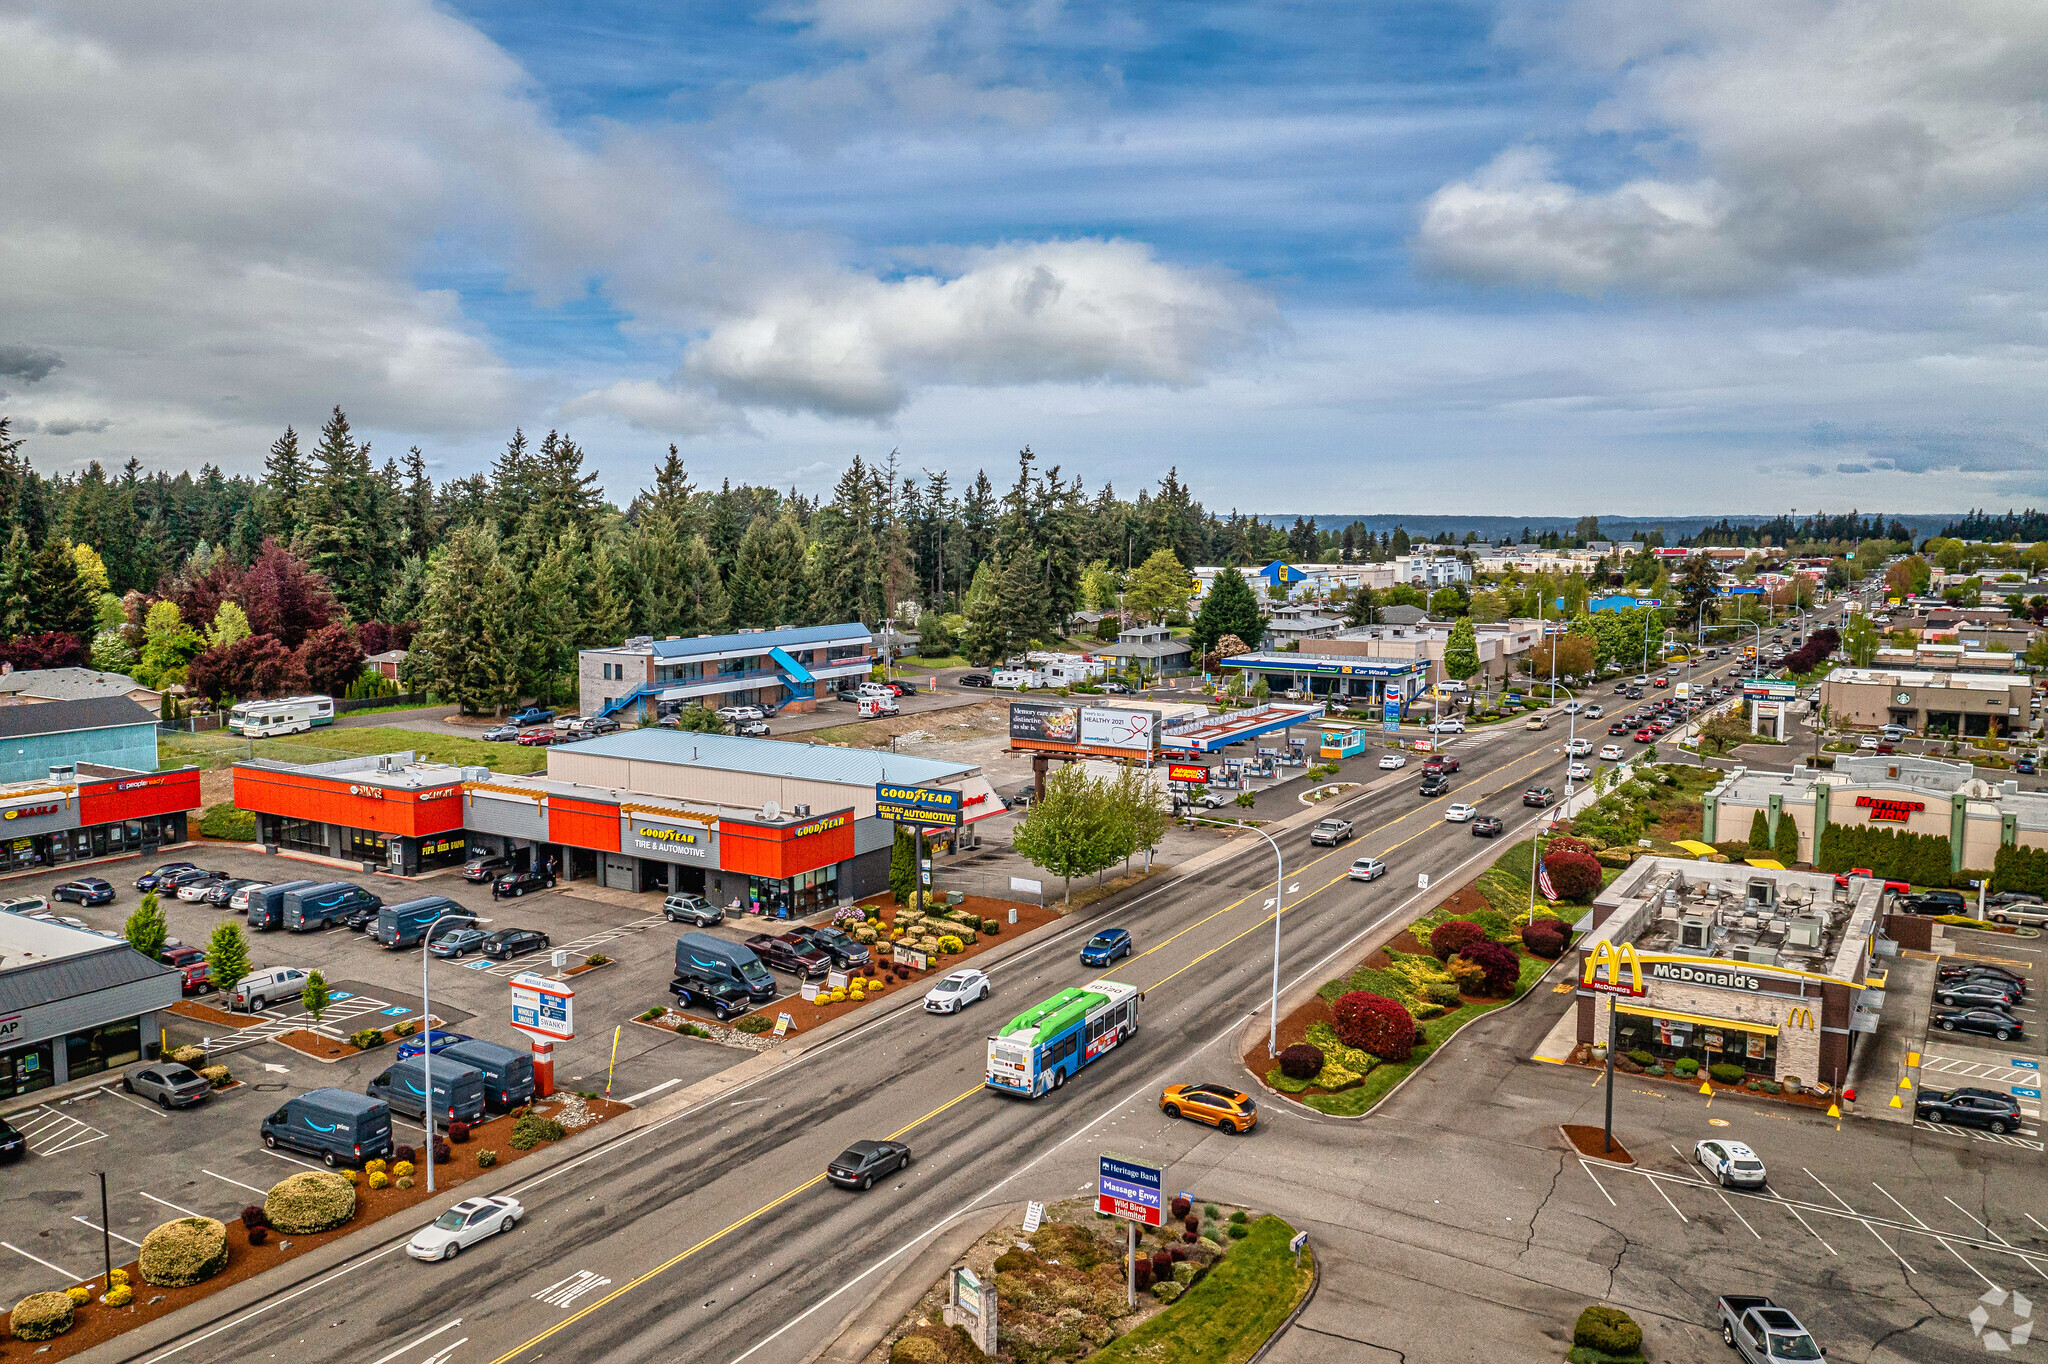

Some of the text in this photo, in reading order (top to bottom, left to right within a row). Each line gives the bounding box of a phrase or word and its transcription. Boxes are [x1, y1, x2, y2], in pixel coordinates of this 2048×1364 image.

[1014, 708, 1036, 716] Memory
[1013, 716, 1041, 724] distinctive
[126, 778, 164, 790] peopleready
[881, 788, 952, 804] GOODYEAR
[17, 804, 59, 818] NAILS
[878, 805, 904, 814] SEA-TAC
[1856, 796, 1925, 812] MATTRESS
[904, 809, 956, 822] AUTOMOTIVE
[1870, 808, 1910, 822] FIRM
[796, 817, 844, 837] GOODYEAR
[640, 828, 696, 844] GOODYEAR
[634, 840, 706, 858] TIRE & AUTOMOTIVE
[1653, 964, 1760, 990] McDonald's
[1594, 982, 1630, 994] McDonald's
[518, 1007, 534, 1018] WHOLLY
[518, 1014, 534, 1025] SMOKES
[1110, 1164, 1158, 1182] Heritage Bank
[1104, 1180, 1158, 1204] Massage Envy
[1114, 1198, 1146, 1214] Wild Birds
[1115, 1206, 1146, 1222] Unlimited
